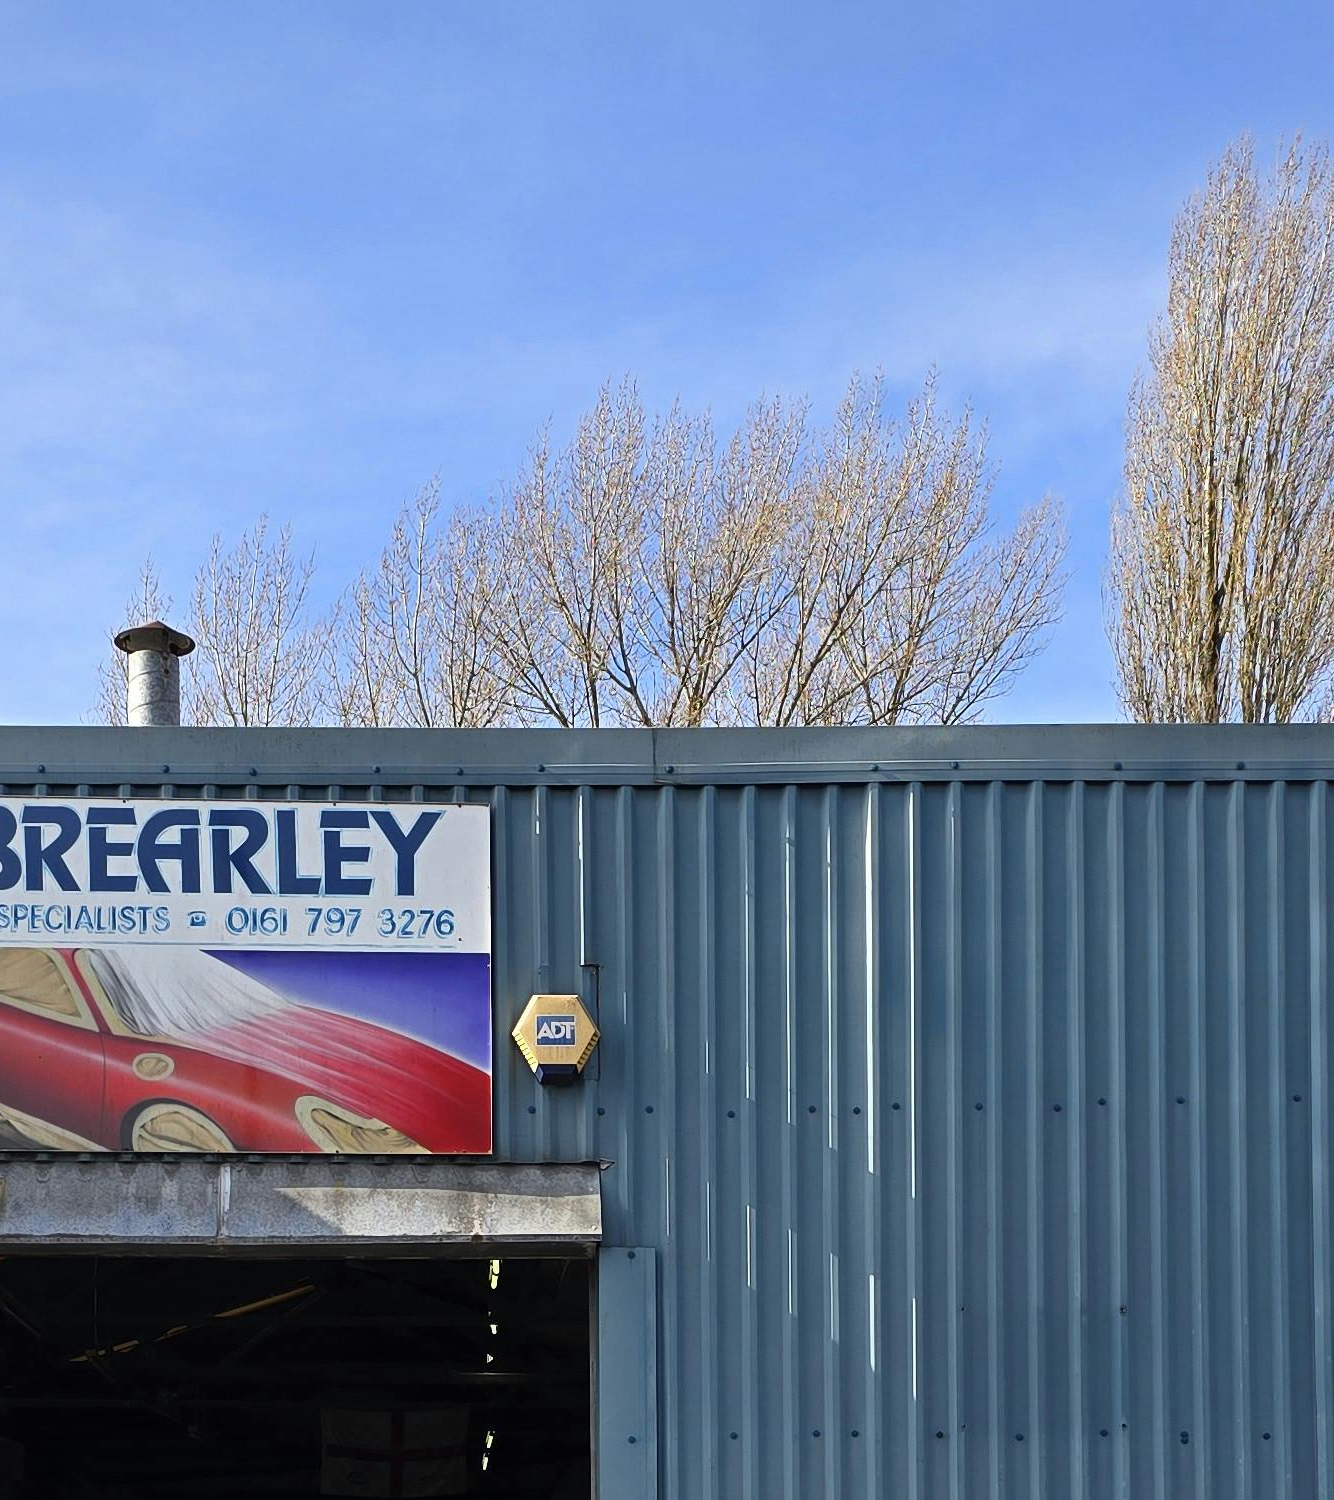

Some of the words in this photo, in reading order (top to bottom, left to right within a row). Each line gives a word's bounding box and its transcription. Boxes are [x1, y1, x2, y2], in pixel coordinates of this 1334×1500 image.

[225, 907, 289, 937] 0161
[305, 907, 362, 938] 797
[377, 908, 456, 939] 3276
[537, 1021, 576, 1039] ADT
